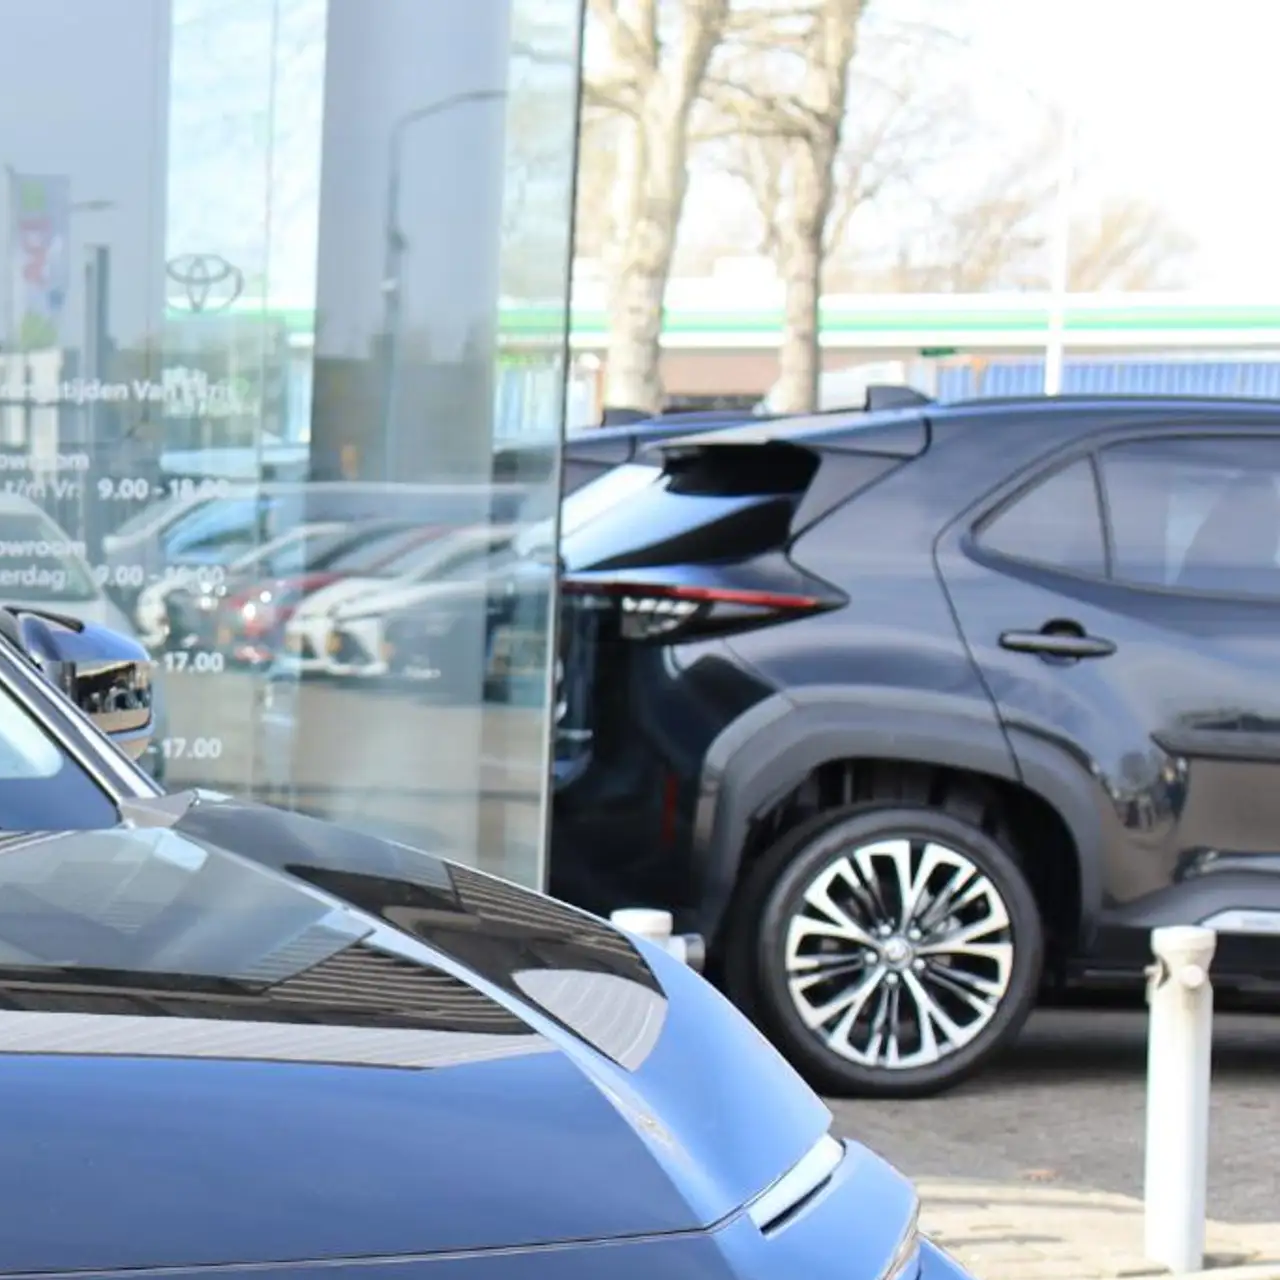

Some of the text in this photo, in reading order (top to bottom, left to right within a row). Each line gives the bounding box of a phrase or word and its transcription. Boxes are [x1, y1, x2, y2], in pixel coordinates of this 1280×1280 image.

[97, 477, 149, 500] 9.00
[163, 652, 225, 673] 17.00
[161, 737, 223, 758] 17.00
